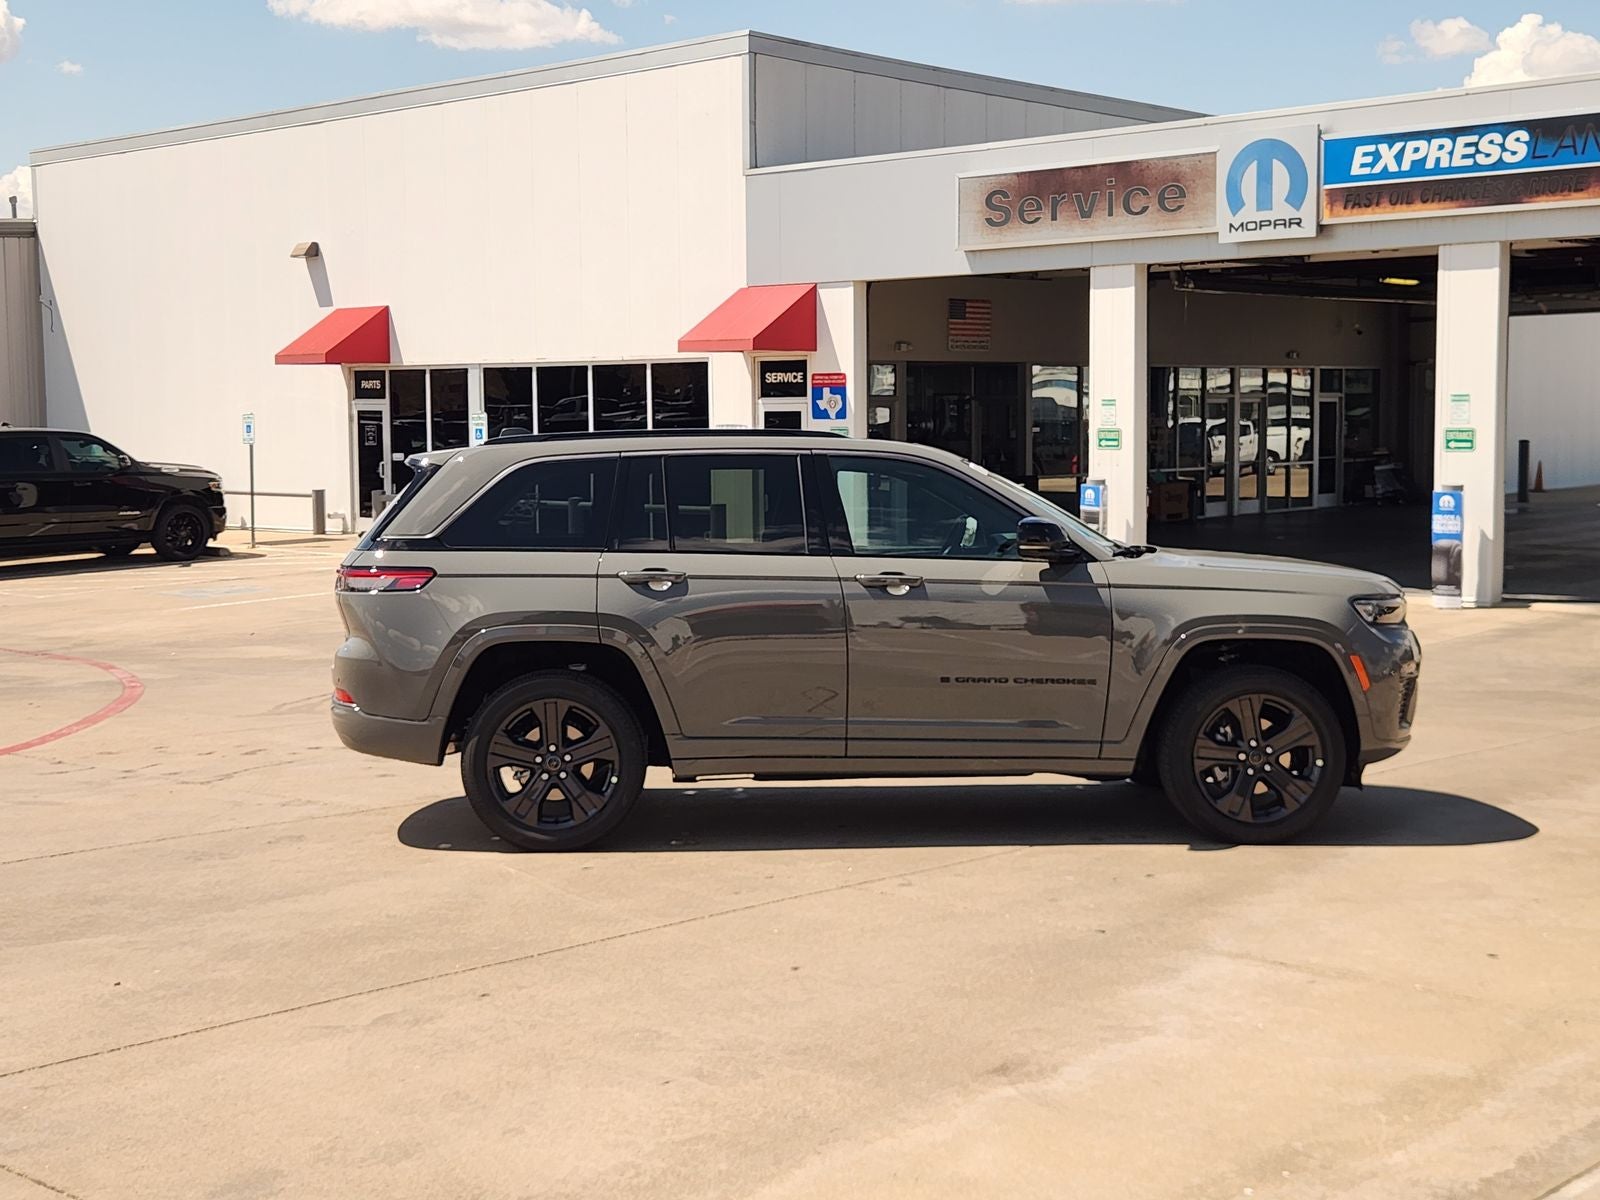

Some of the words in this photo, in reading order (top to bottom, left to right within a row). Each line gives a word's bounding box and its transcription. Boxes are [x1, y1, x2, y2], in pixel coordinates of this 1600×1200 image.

[1350, 130, 1530, 176] EXPRESS
[1343, 190, 1385, 210] FAST
[1389, 188, 1414, 206] OIL
[1419, 179, 1506, 204] CHANGES
[1528, 173, 1590, 196] MORE
[984, 178, 1188, 228] Service
[1229, 216, 1305, 234] MOPAR
[361, 380, 381, 389] PARTS
[765, 372, 804, 383] SERVICE
[954, 676, 1009, 684] GRAND
[1013, 677, 1097, 685] CHEROKEE
